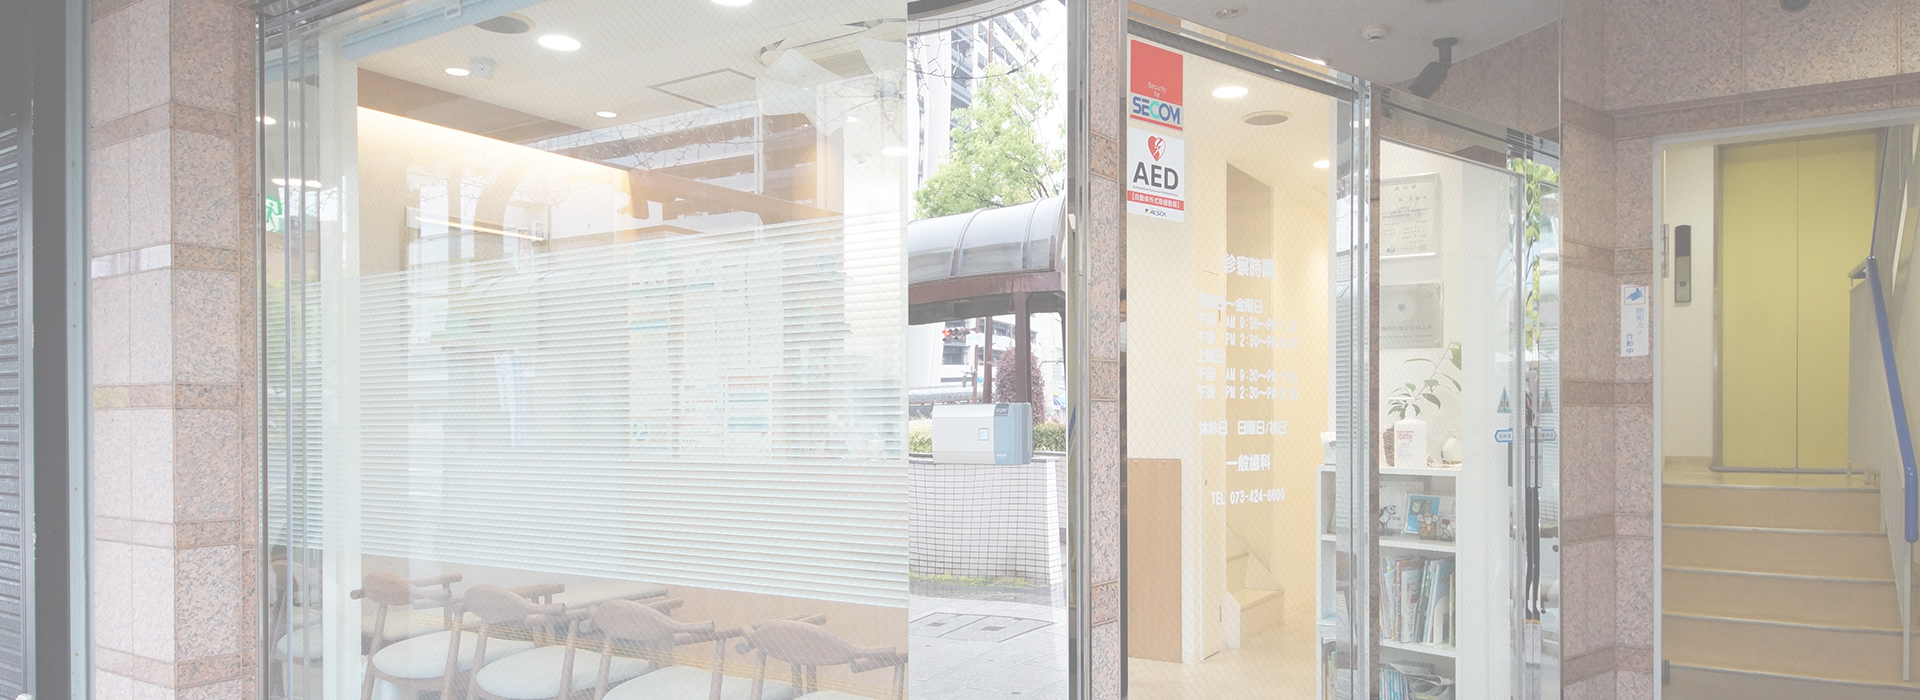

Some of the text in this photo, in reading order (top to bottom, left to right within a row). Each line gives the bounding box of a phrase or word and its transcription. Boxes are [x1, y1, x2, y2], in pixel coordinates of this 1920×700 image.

[1147, 81, 1167, 95] Security
[1154, 91, 1161, 99] by
[1132, 96, 1180, 124] SECOM
[1132, 161, 1179, 190] AED
[1223, 254, 1275, 280] 診察時間
[1225, 315, 1236, 329] AM
[1225, 333, 1236, 346] PM
[1196, 348, 1226, 364] 土曜日
[1225, 368, 1236, 382] AM
[1225, 385, 1236, 399] PM
[1199, 420, 1288, 435] 休診日 日曜日/祝日
[1226, 453, 1271, 472] 一般歯科
[1211, 489, 1285, 505] TEL 073-424-6000
